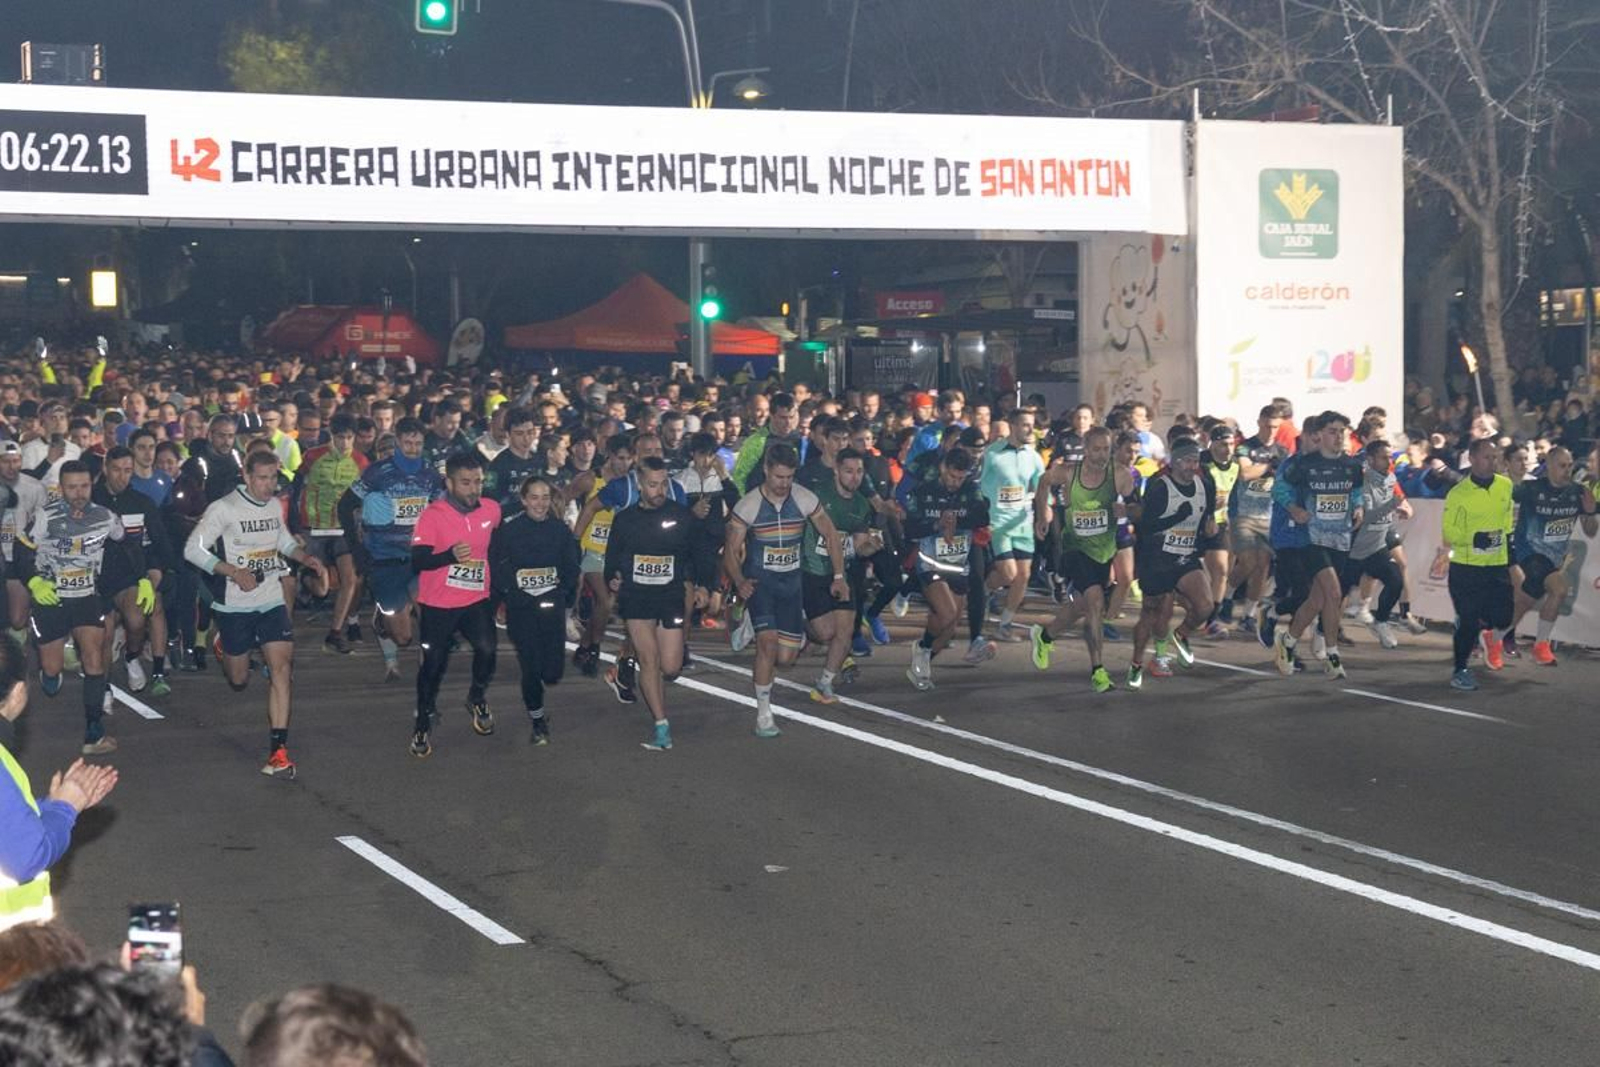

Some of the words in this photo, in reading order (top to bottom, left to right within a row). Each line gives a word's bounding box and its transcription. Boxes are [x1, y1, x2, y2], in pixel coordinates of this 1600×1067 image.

[0, 131, 132, 174] 06:22.13
[170, 137, 221, 182] 42
[231, 140, 399, 186] CARRERA
[410, 147, 542, 190] URBANA
[551, 151, 819, 194] INTERNACIONAL
[828, 156, 925, 195] NOCHE
[934, 157, 971, 196] DE
[980, 158, 1034, 196] SAN
[1245, 281, 1350, 301] calderón
[1319, 501, 1346, 511] 5209
[1076, 516, 1104, 527] 5981
[452, 565, 484, 580] 7215
[637, 563, 670, 574] 4882
[60, 575, 91, 588] 9451
[520, 575, 555, 587] 5535
